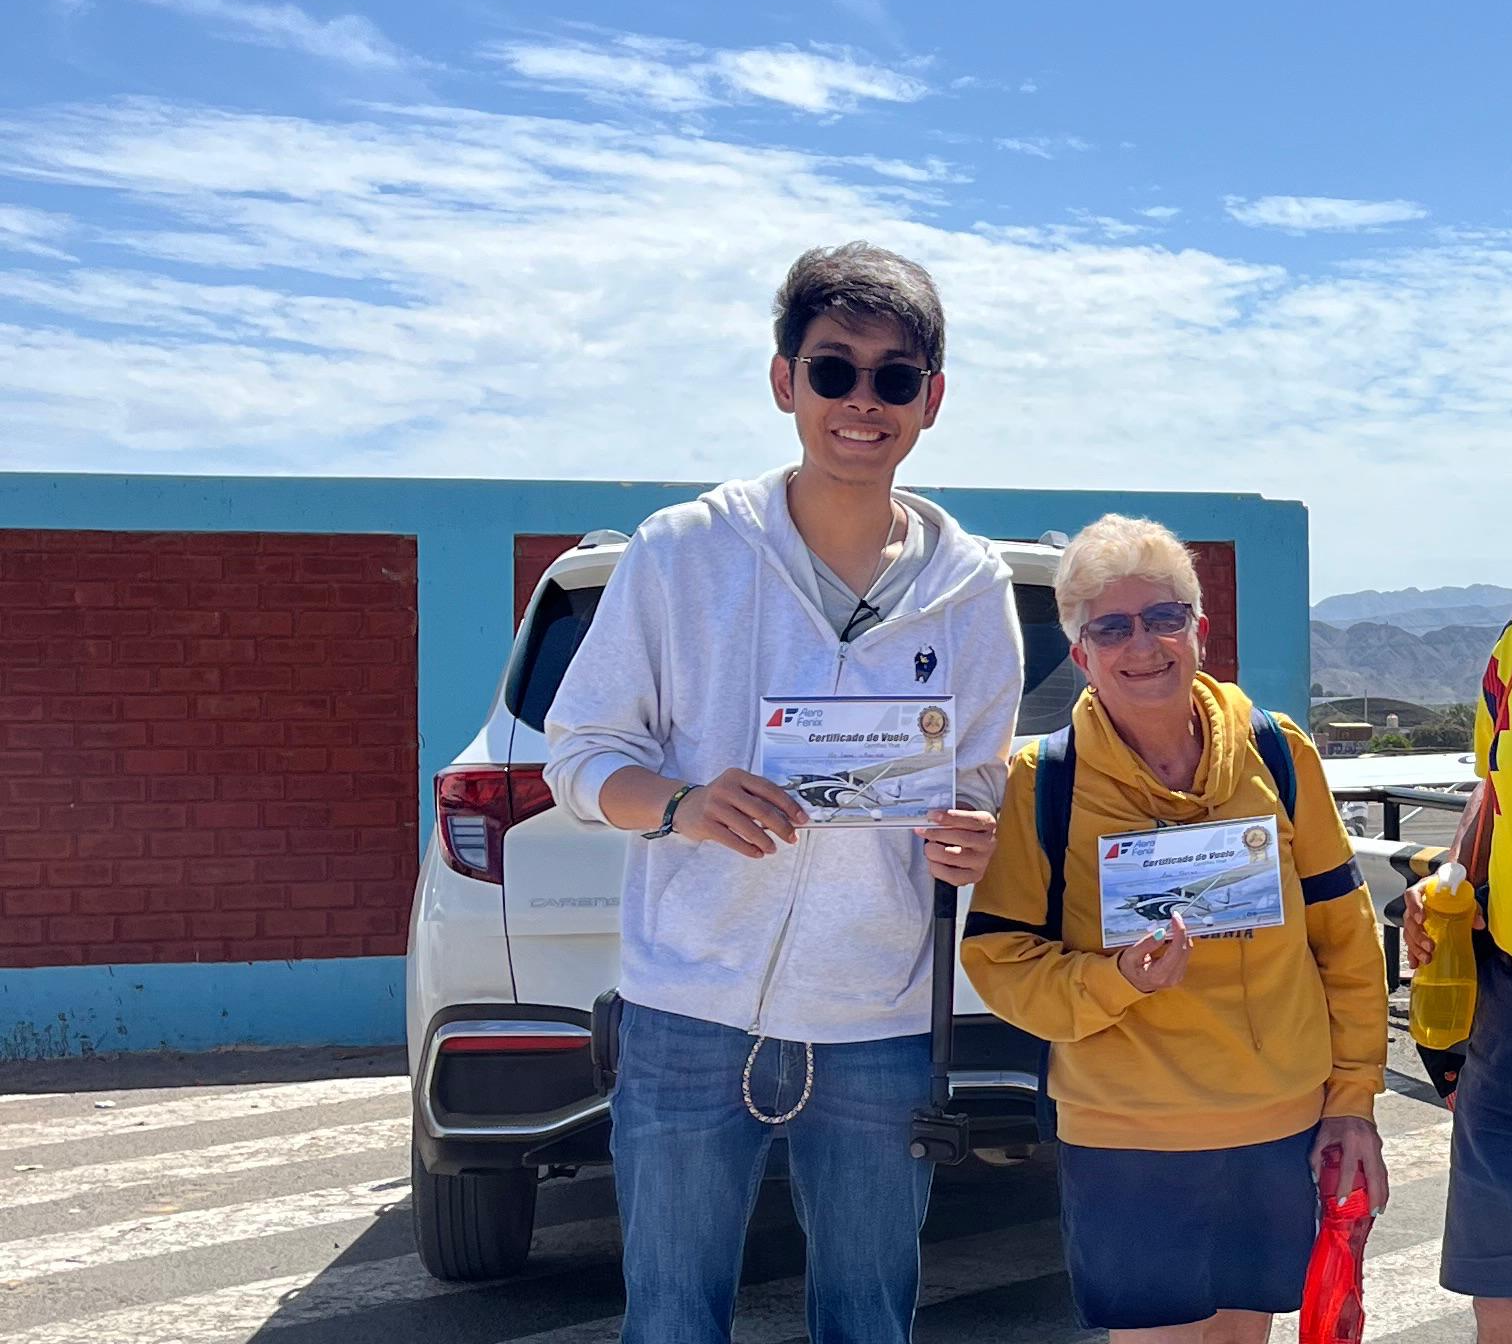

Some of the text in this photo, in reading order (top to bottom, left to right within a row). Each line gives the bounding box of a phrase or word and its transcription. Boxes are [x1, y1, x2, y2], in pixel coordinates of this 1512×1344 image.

[799, 708, 824, 717] Aero
[808, 732, 909, 743] Certificado de Vuelo
[1135, 839, 1156, 848] Aero
[1143, 850, 1235, 867] Certificado de Vuelo
